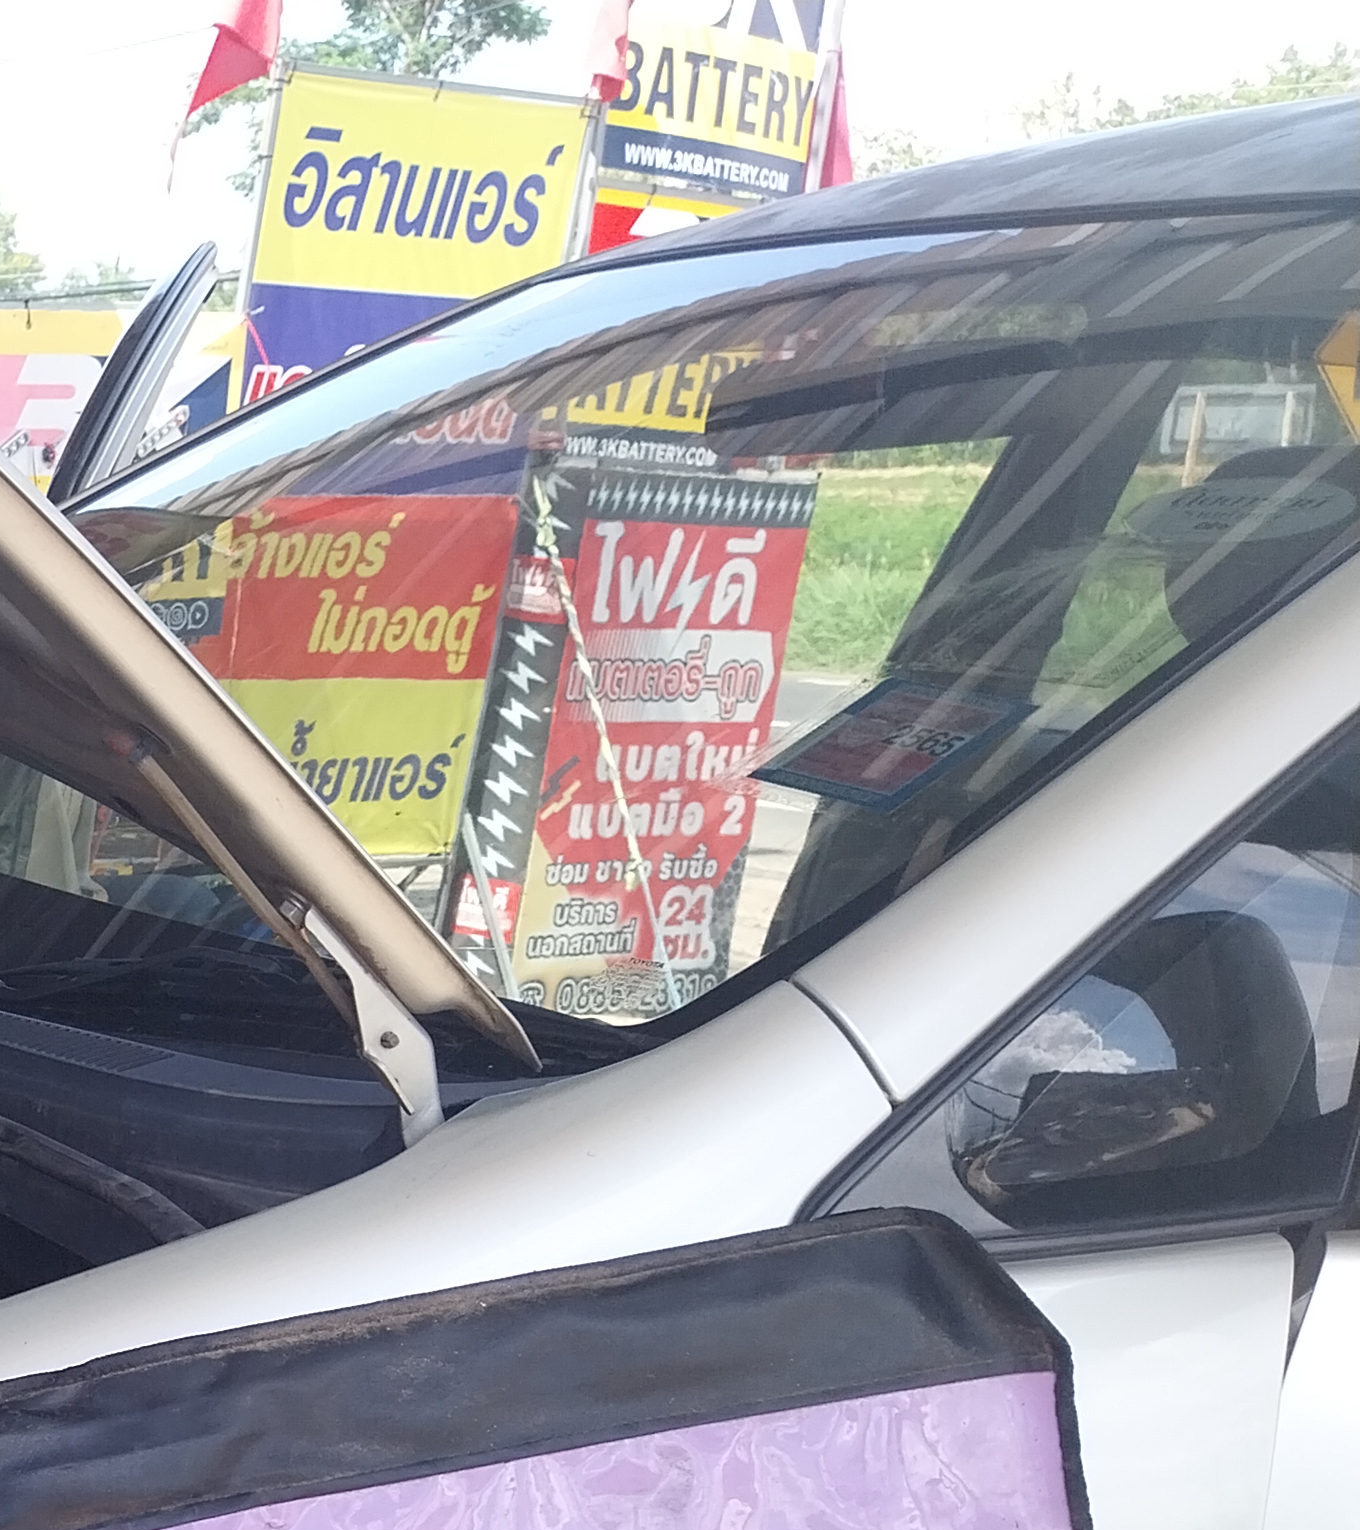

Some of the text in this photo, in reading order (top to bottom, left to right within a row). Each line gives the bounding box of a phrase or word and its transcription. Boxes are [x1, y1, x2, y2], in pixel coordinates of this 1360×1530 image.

[624, 142, 790, 192] WWW.3KBATTERY.COM
[283, 126, 565, 247] อิสานแอร์
[564, 434, 718, 467] WW.3KBATTERY.COM
[881, 724, 965, 756] 2565
[290, 719, 467, 804] ้ำยาแอร์
[720, 795, 746, 836] 2
[664, 895, 707, 927] 24
[629, 957, 665, 969] TOYOTA
